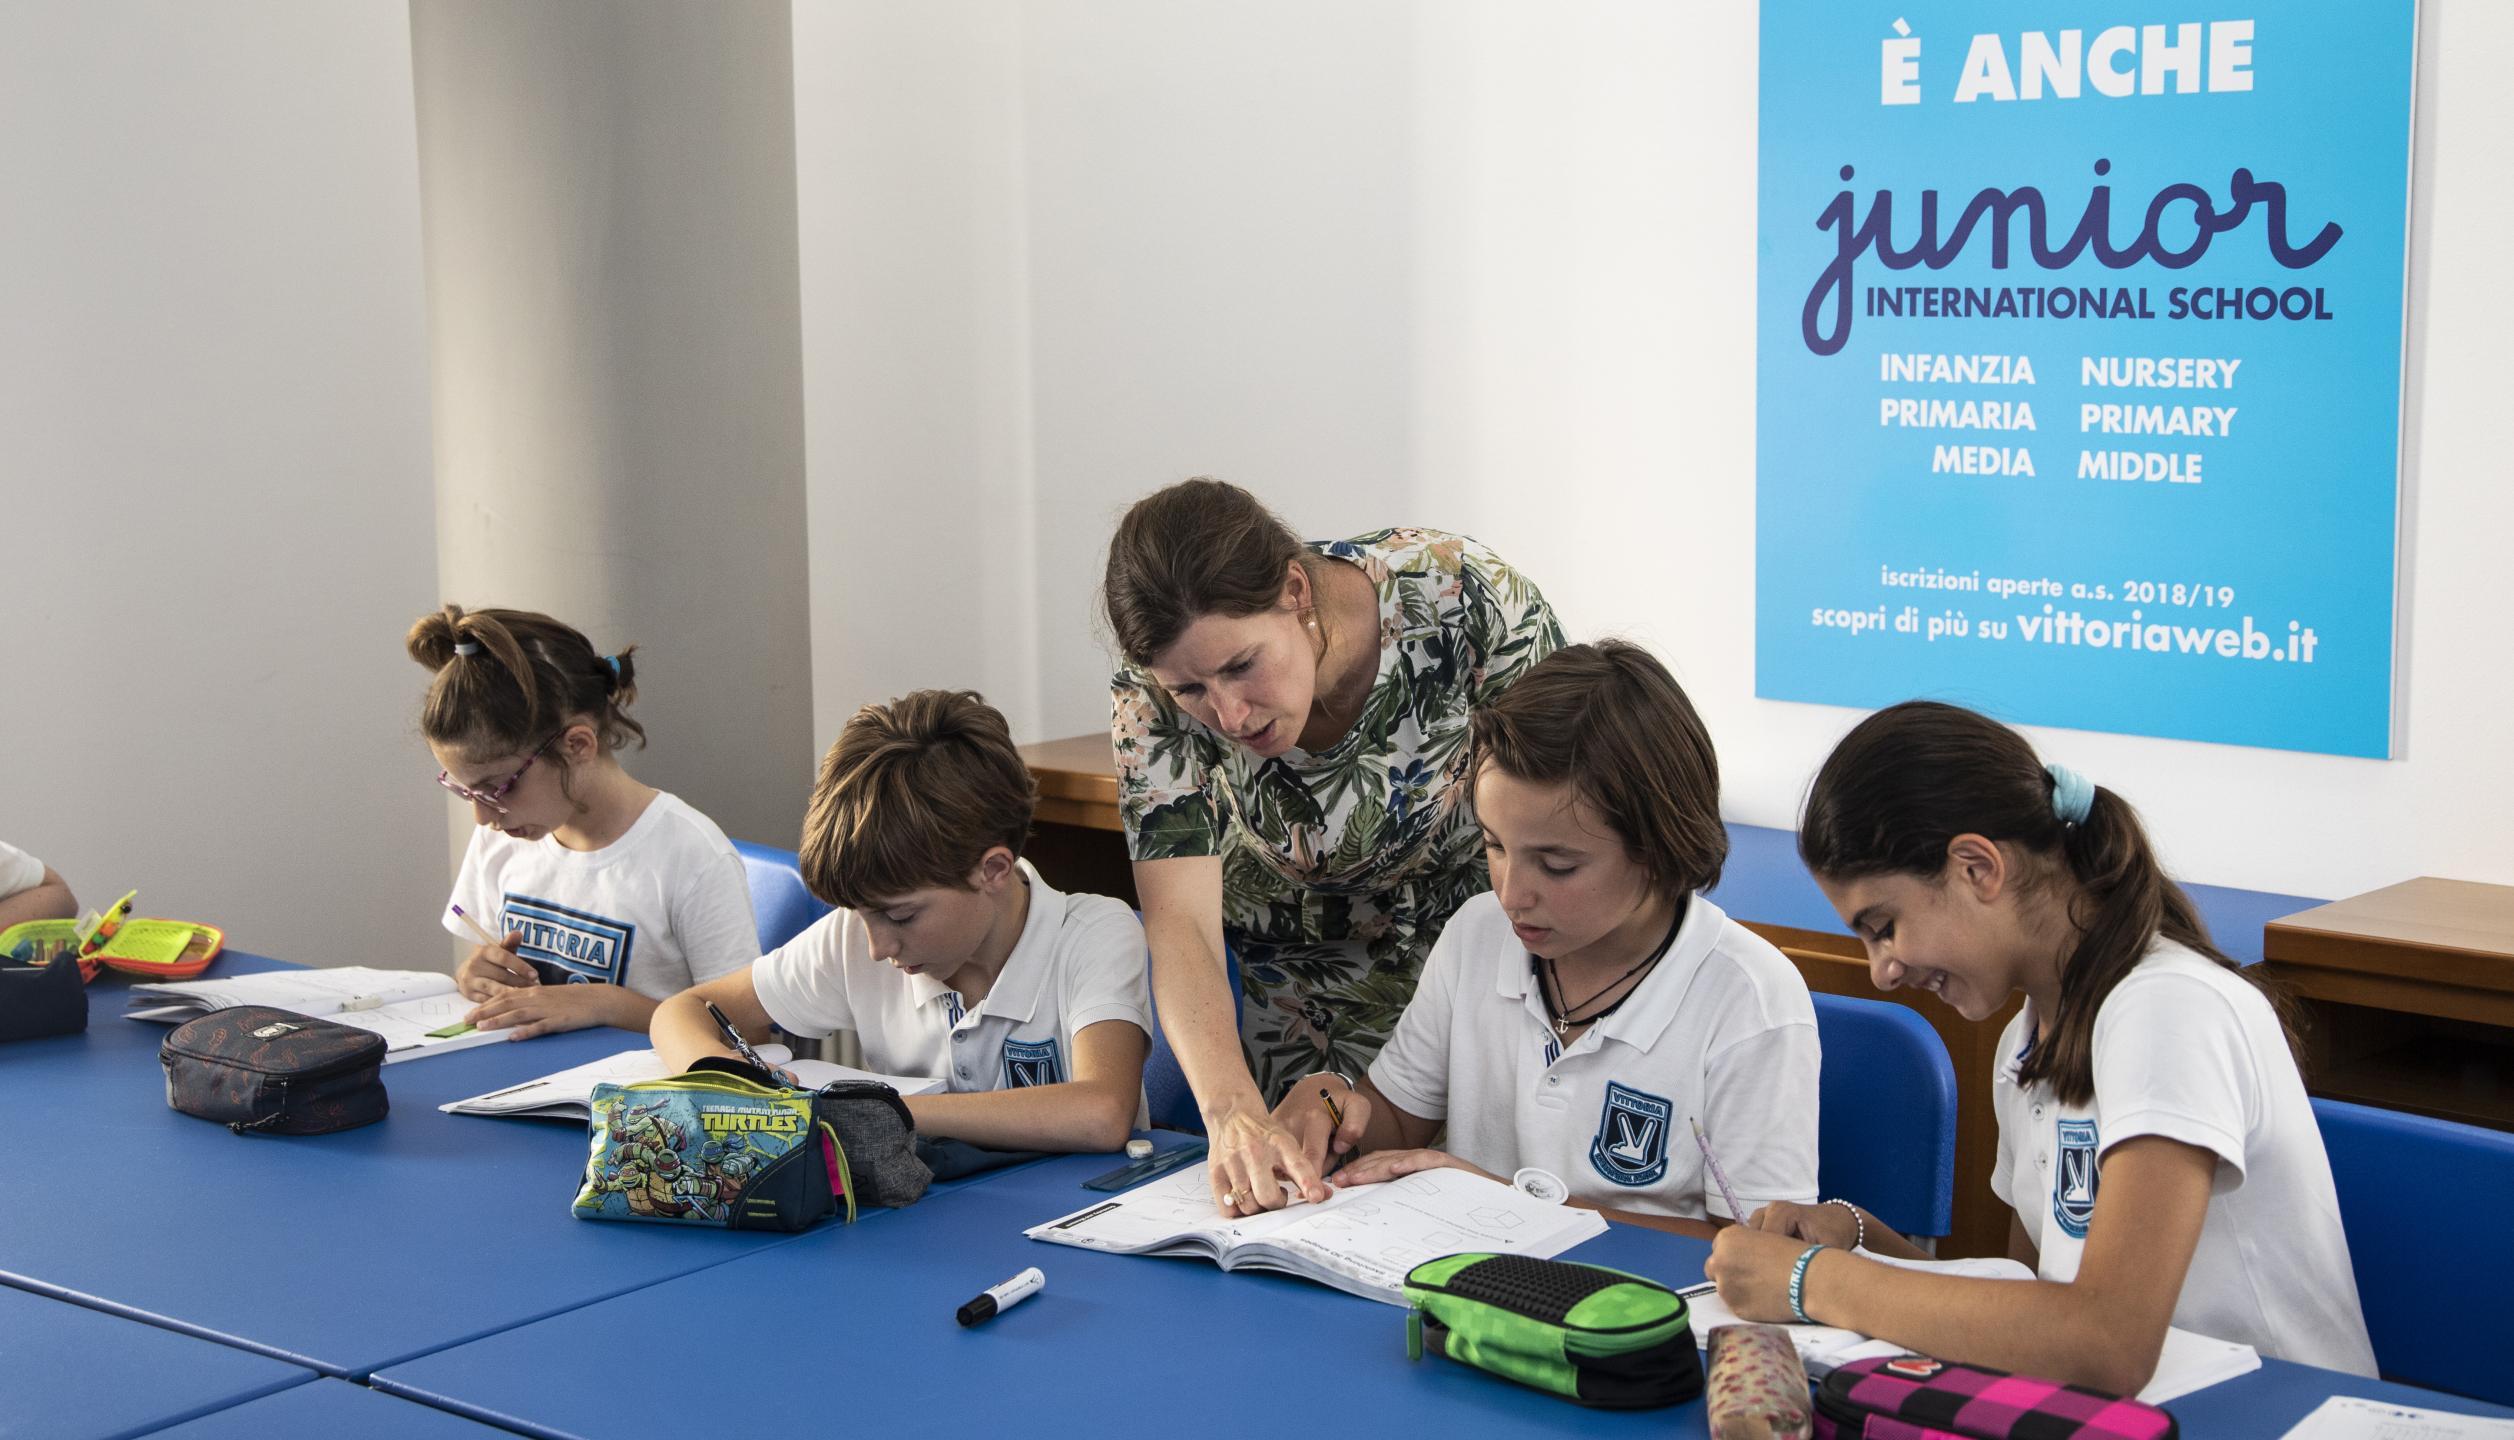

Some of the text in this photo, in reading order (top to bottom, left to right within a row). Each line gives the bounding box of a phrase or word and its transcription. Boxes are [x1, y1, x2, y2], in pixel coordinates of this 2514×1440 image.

[1881, 18, 2254, 105] È ANCHE
[1802, 159, 2343, 356] junior
[1868, 287, 2333, 320] INTERNATIONAL SCHOOL
[1881, 353, 2035, 384] INFANZIA
[2082, 357, 2240, 388] NURSERY
[1881, 398, 2036, 430] PRIMARIA
[2081, 404, 2237, 436] PRIMARY
[1933, 445, 2035, 477] MEDIA
[2078, 451, 2202, 483] MIDDLE
[1882, 565, 2234, 608] iscrizioni aperte a.s. 2018/19
[1812, 604, 2317, 662] scopri di più su vittoriaweb.it
[508, 917, 606, 965] VITTORIA
[1613, 1091, 1664, 1116] VITTORIA
[701, 1113, 797, 1132] TURTLES
